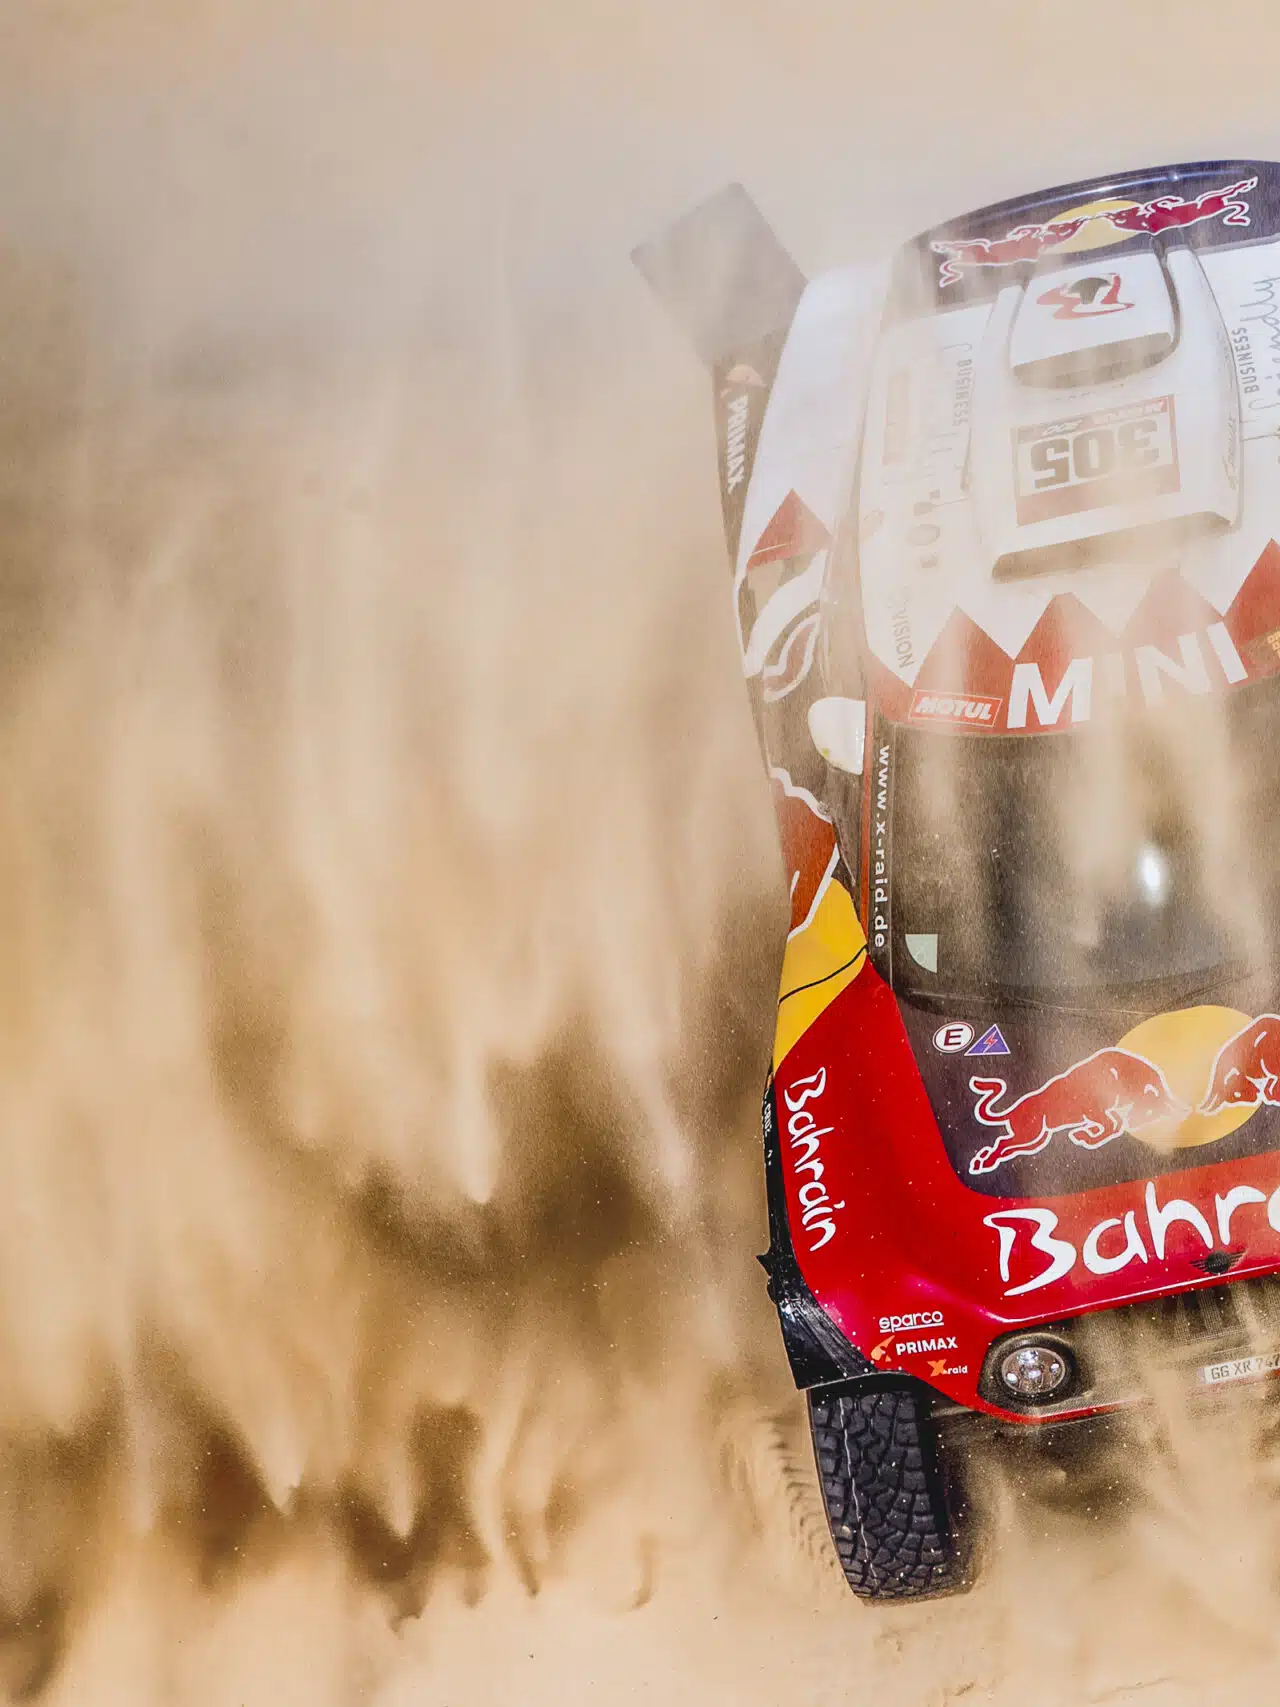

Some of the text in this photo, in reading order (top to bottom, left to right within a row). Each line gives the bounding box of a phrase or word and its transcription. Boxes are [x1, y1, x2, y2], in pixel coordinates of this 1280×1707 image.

[1231, 327, 1260, 394] BUSINESS
[727, 394, 749, 494] PRIMAX
[915, 697, 993, 721] MOTUL
[874, 744, 890, 948] www.x-raid.de
[784, 1066, 846, 1251] Bahrain
[879, 1311, 944, 1333] sparco
[895, 1336, 958, 1355] PRIMAX
[1211, 1365, 1229, 1380] GG
[1234, 1360, 1250, 1375] XR
